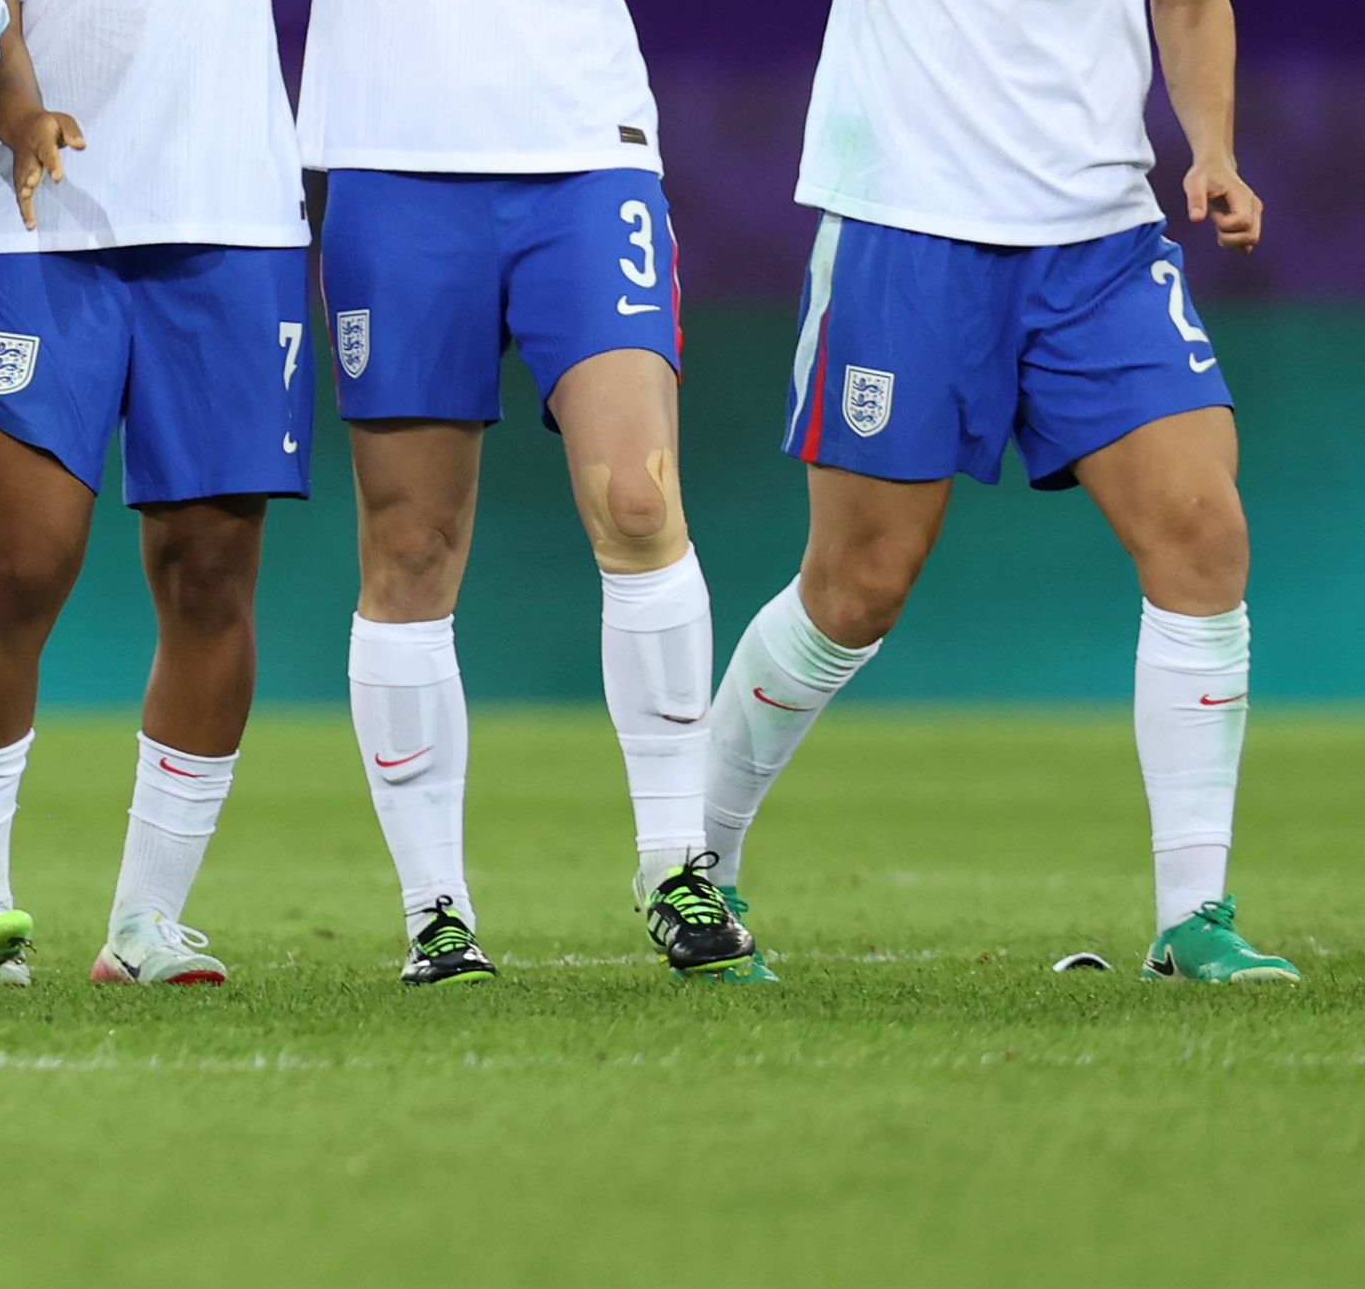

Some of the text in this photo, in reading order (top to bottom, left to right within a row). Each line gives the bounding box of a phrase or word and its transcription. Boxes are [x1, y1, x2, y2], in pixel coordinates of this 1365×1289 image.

[619, 199, 657, 288] 3
[1151, 260, 1209, 342] 2
[279, 322, 302, 391] 7
